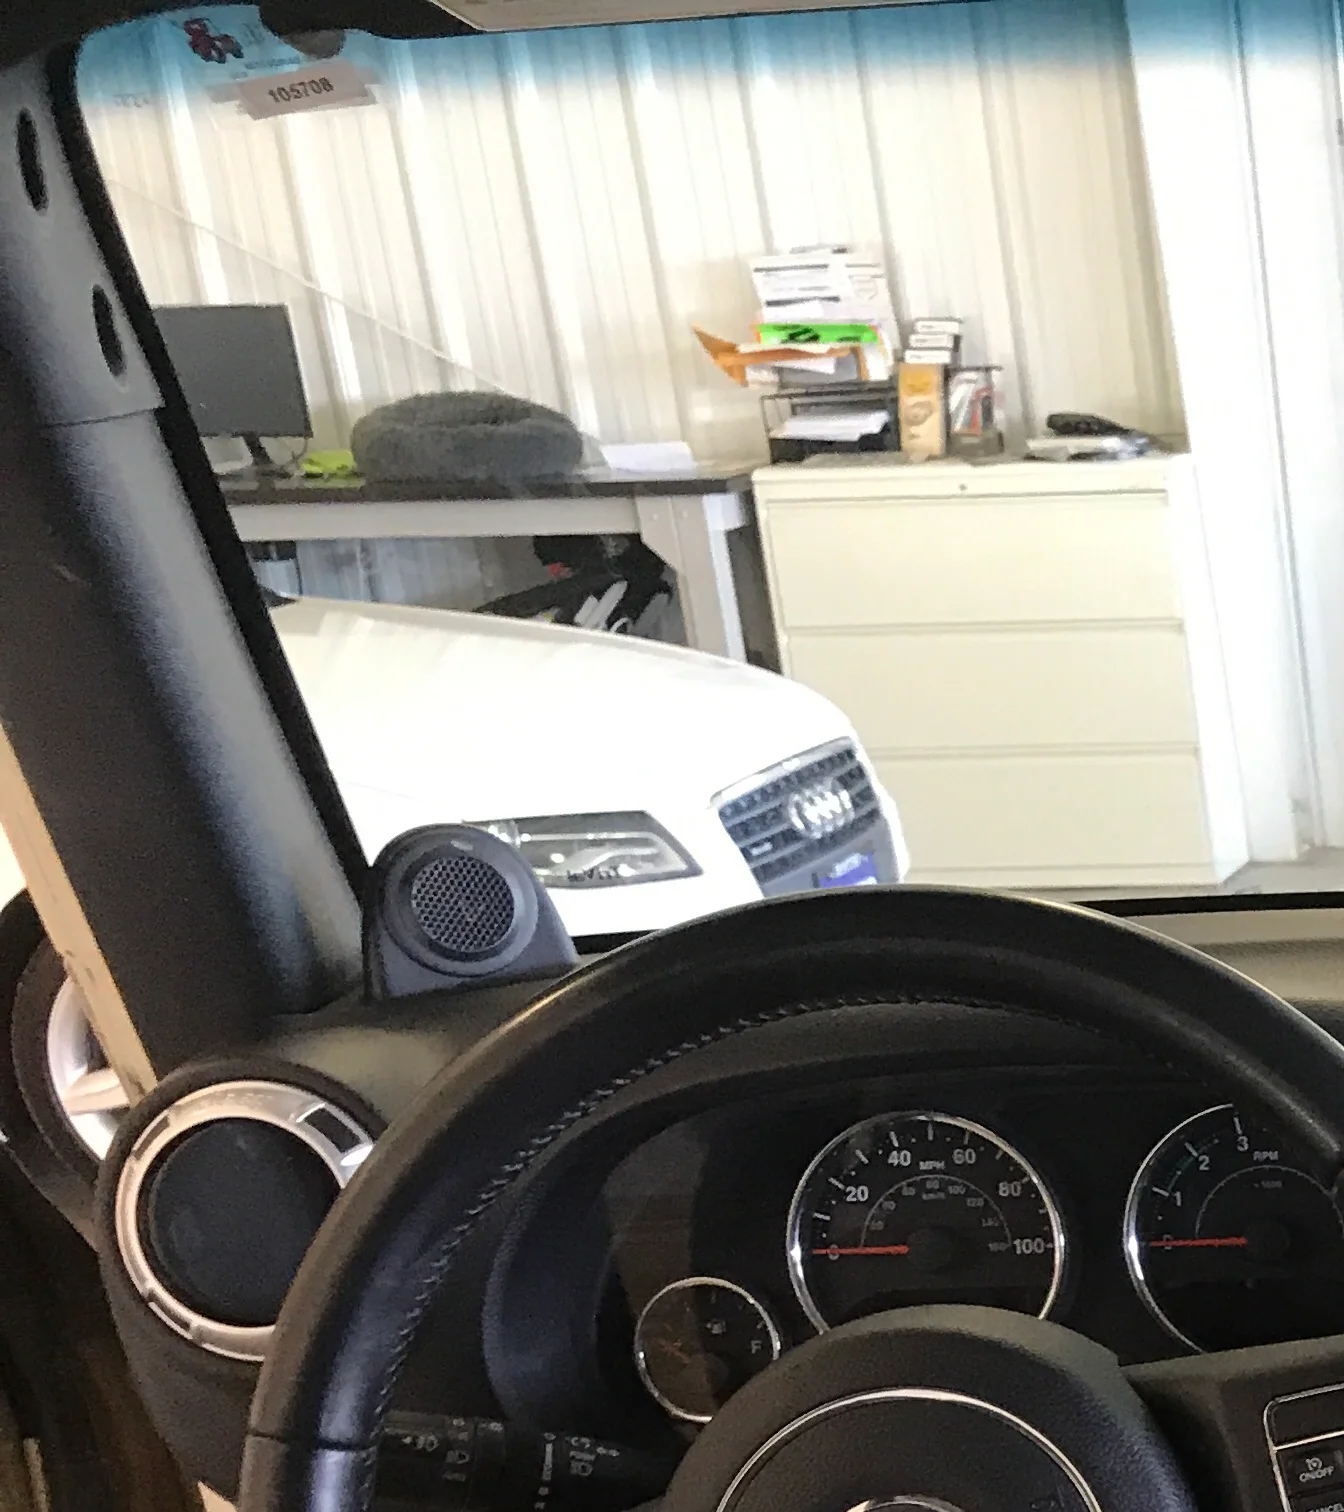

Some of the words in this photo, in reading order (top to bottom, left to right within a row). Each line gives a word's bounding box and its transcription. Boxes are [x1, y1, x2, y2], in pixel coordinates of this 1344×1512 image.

[266, 76, 334, 103] 105708
[1237, 1136, 1250, 1152] 3
[888, 1149, 912, 1166] 40
[952, 1148, 976, 1166] 60
[1199, 1155, 1211, 1171] 2
[1253, 1150, 1279, 1161] RPM
[919, 1160, 946, 1171] MPH
[846, 1185, 869, 1203] 20
[999, 1180, 1022, 1198] 80
[1172, 1190, 1183, 1207] 1
[1013, 1237, 1046, 1255] 100
[750, 1339, 762, 1355] F
